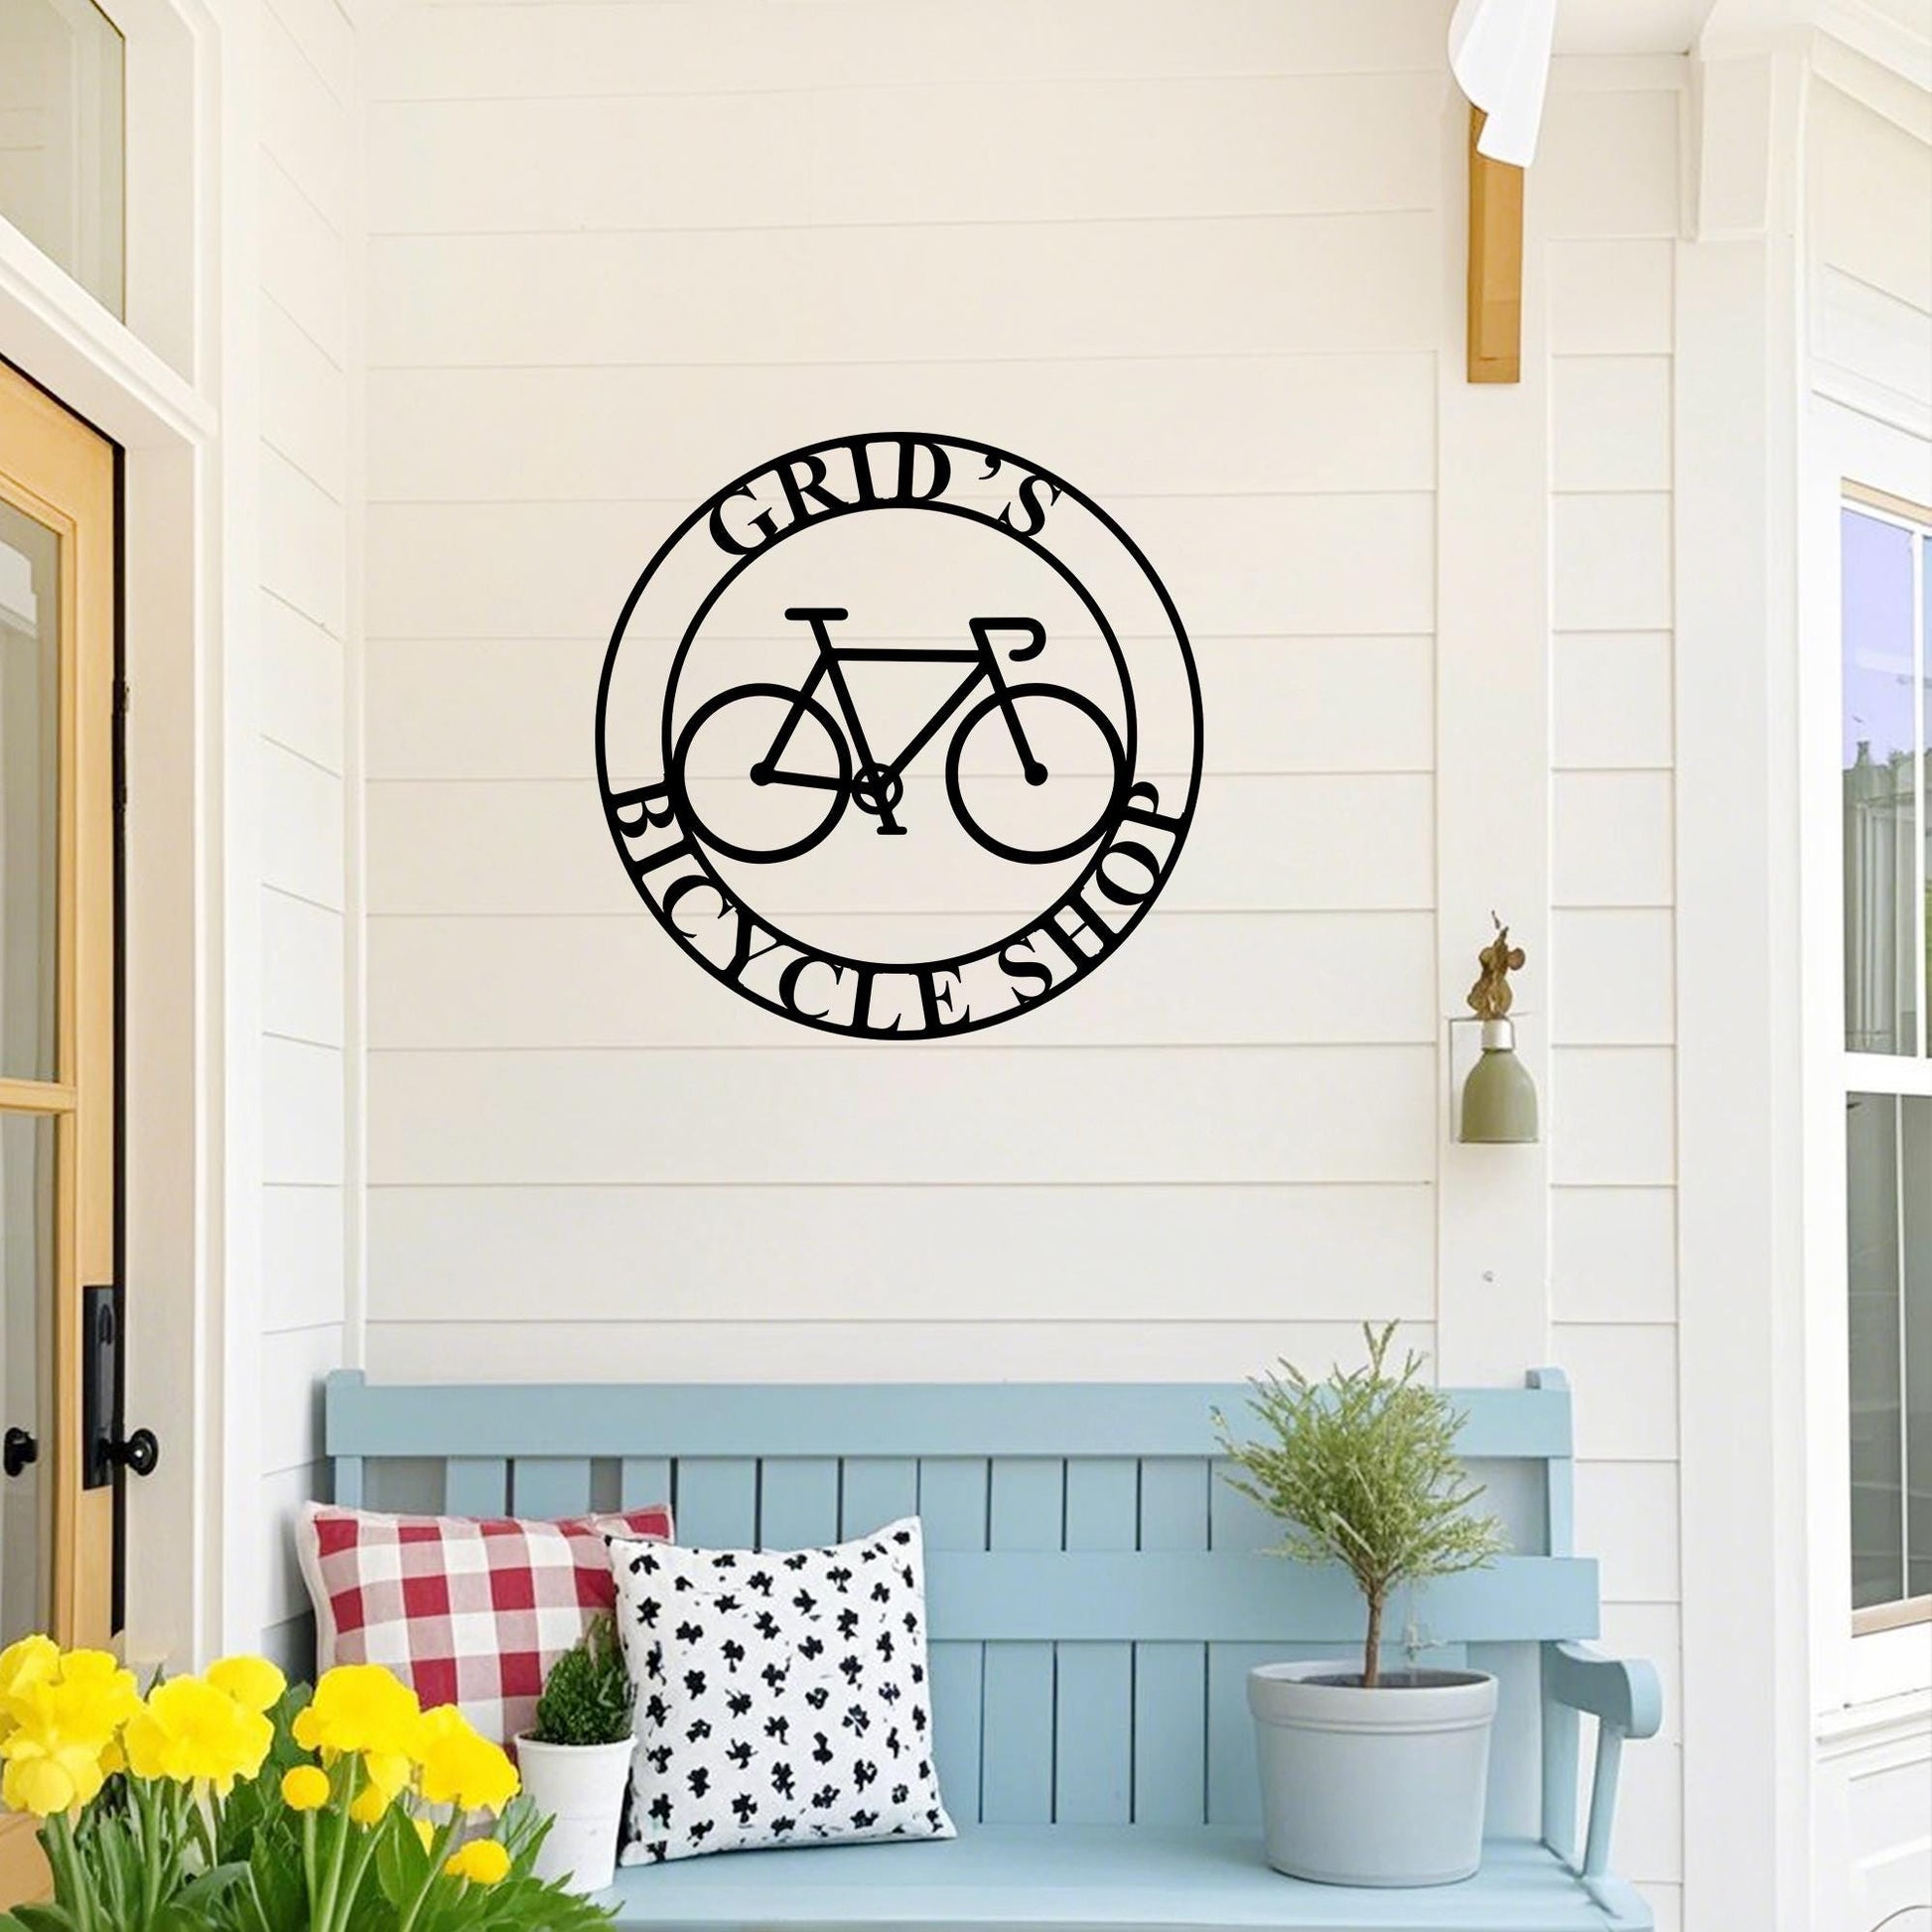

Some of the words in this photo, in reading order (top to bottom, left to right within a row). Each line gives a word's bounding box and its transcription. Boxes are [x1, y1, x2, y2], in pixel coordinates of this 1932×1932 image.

[709, 442, 1063, 555] GRID'S
[606, 774, 971, 1032] BICYCLE
[997, 780, 1186, 1006] SHOP
